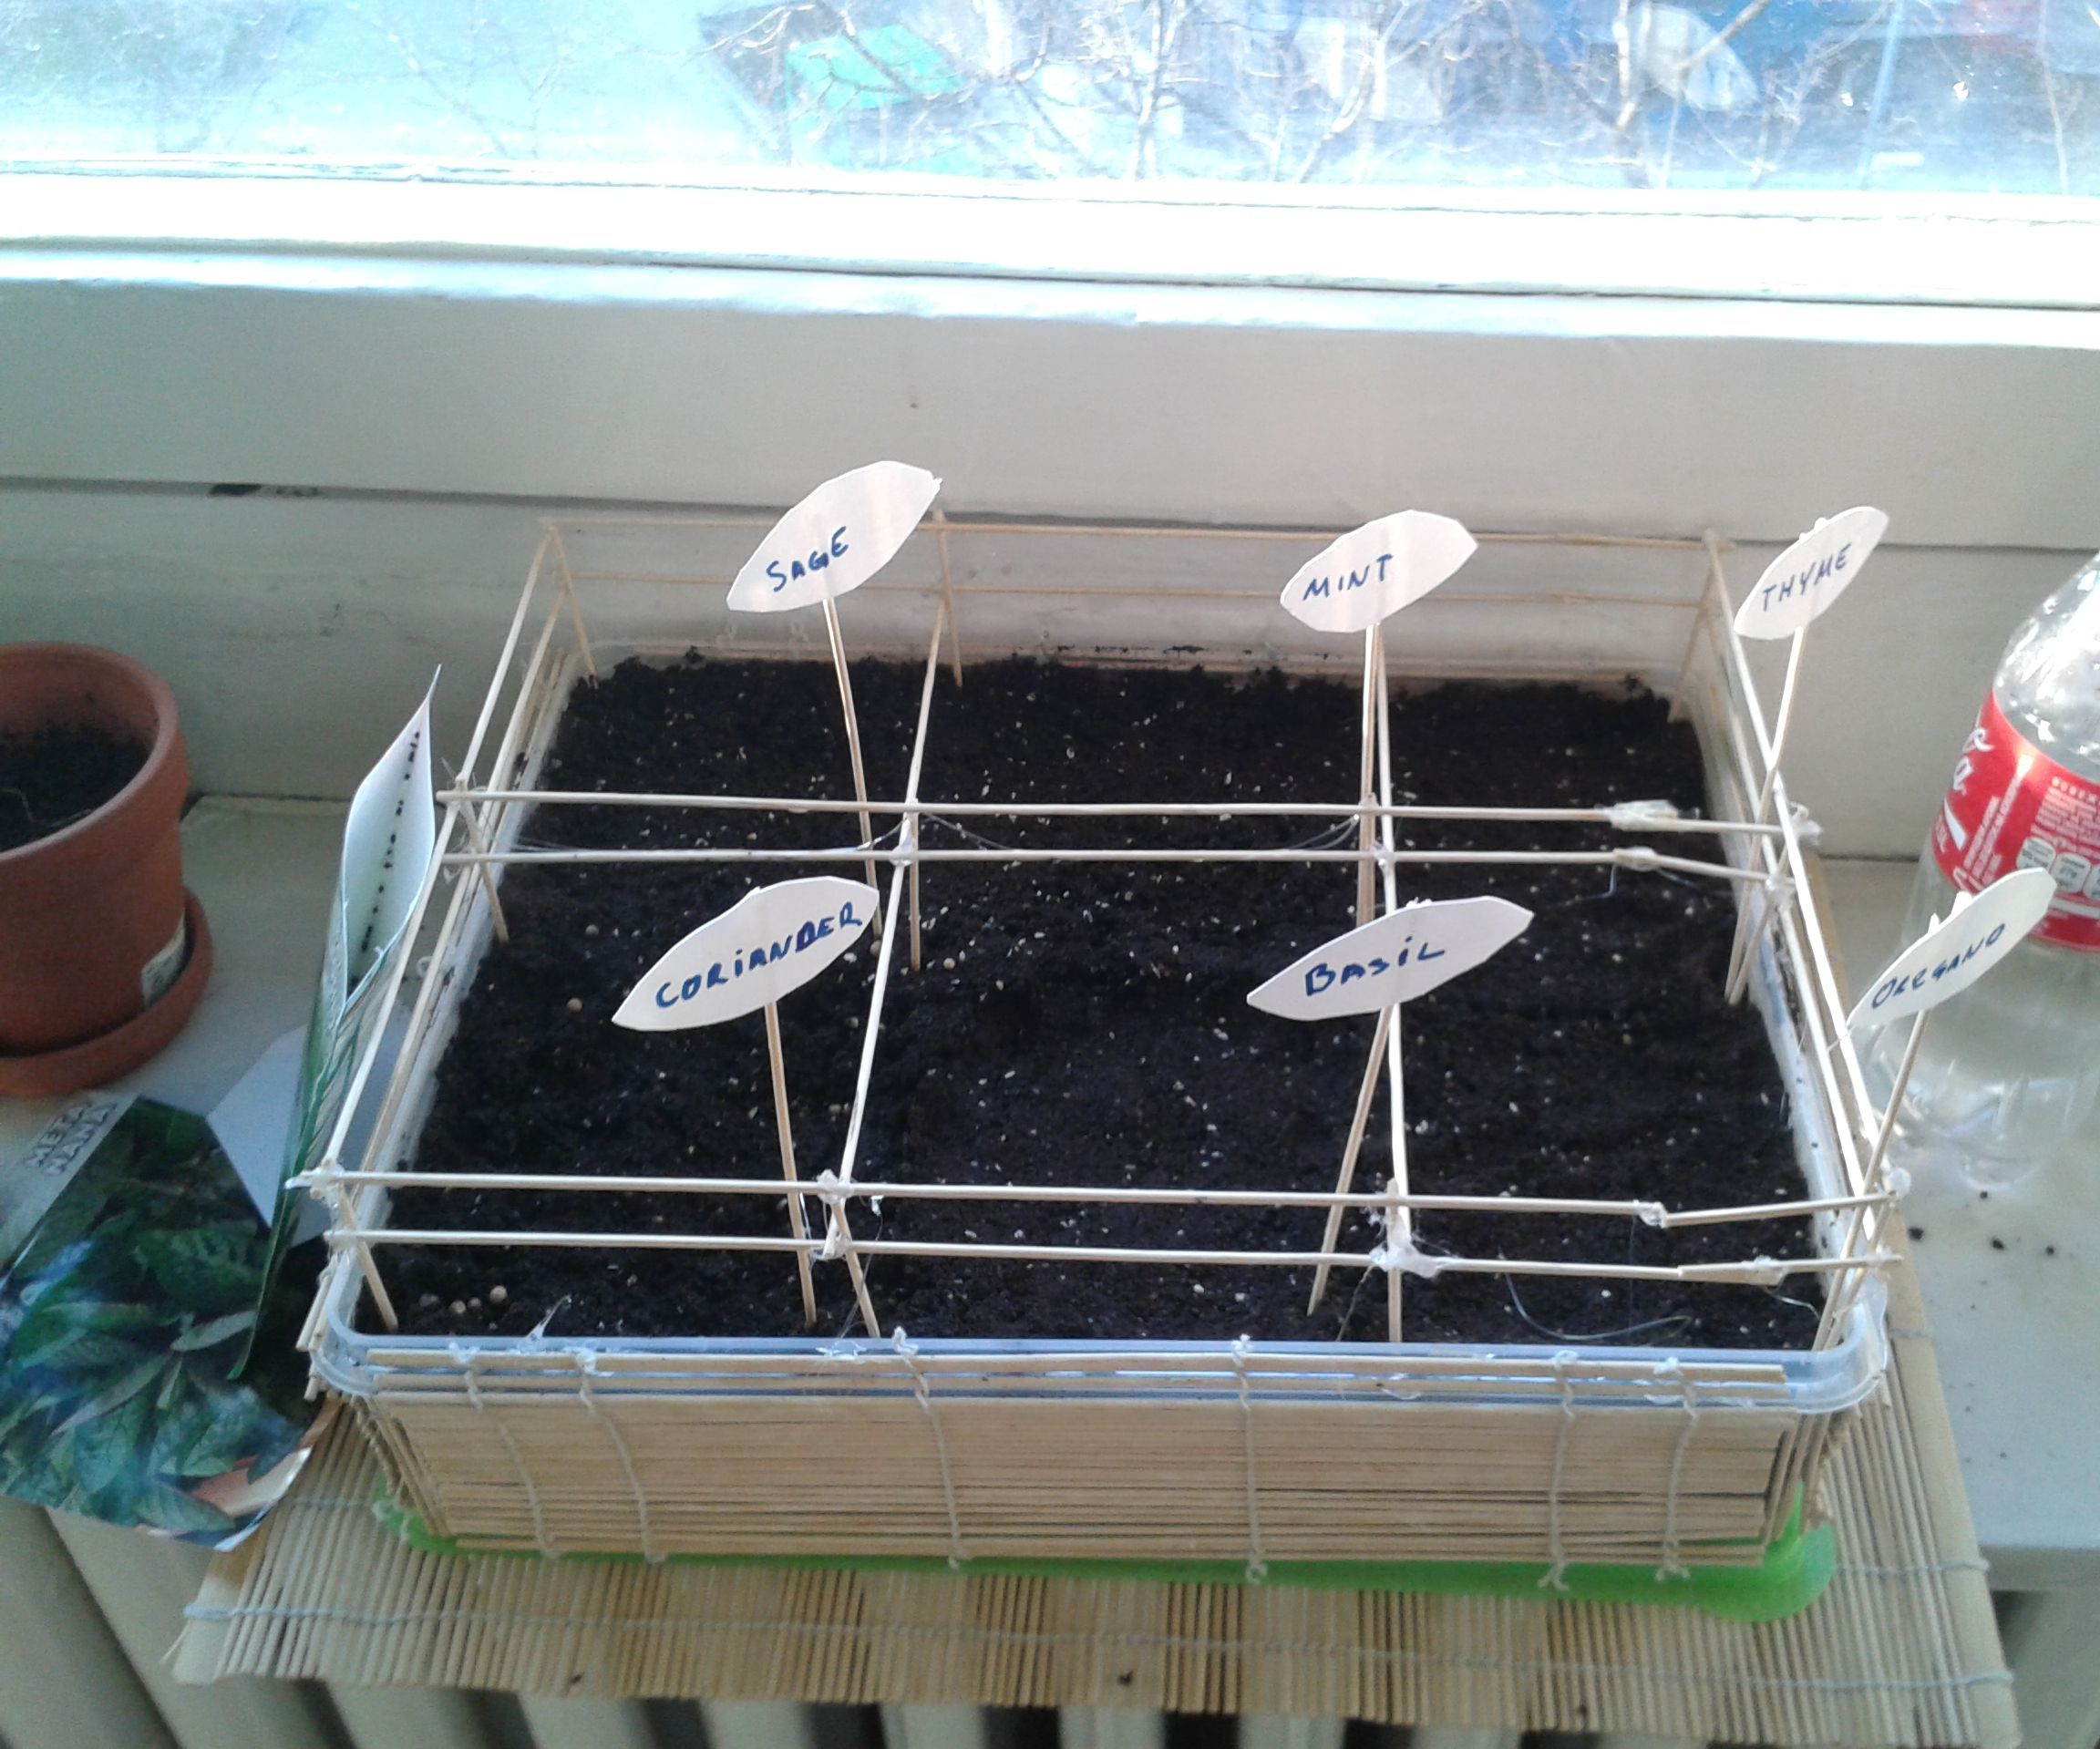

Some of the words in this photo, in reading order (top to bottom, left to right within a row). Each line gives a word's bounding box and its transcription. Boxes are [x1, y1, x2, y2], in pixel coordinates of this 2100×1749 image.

[766, 525, 849, 592] SAGE
[1302, 553, 1393, 601] MINT
[1763, 542, 1851, 612] THYME
[1871, 923, 2005, 1009] OREGANO
